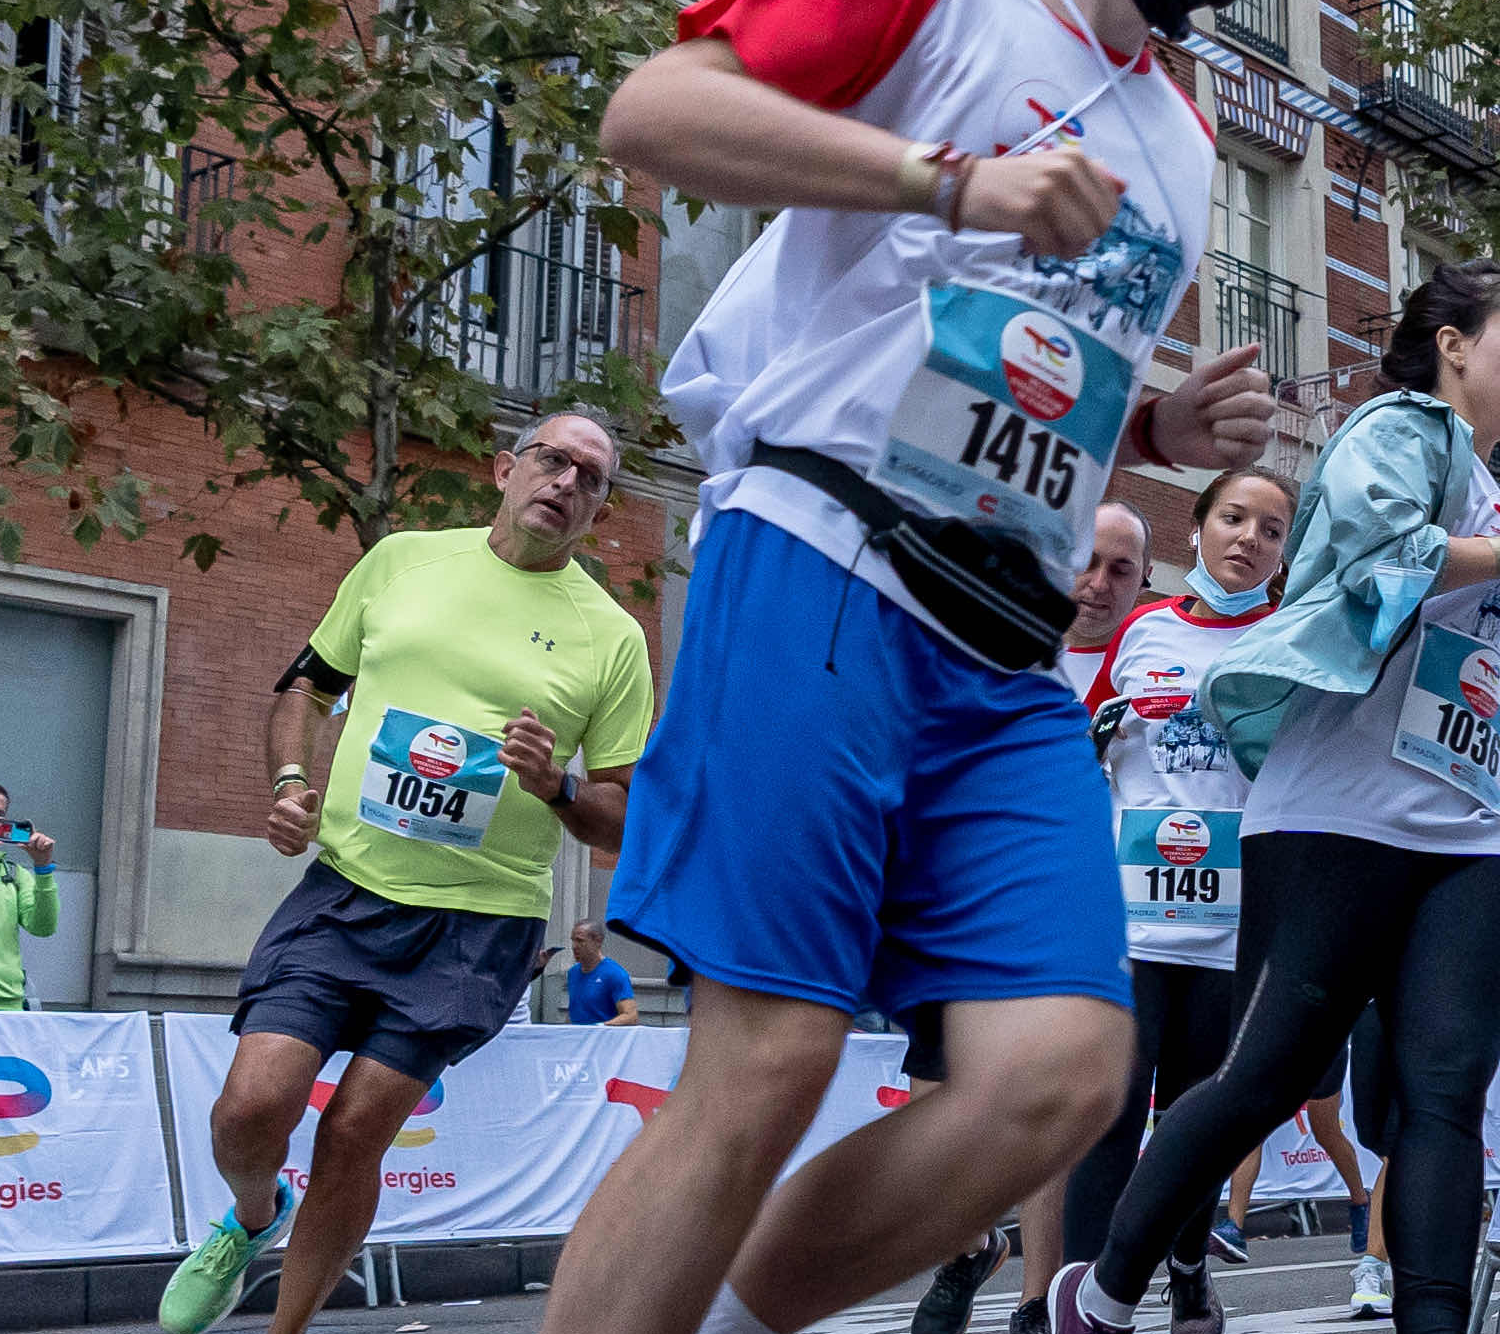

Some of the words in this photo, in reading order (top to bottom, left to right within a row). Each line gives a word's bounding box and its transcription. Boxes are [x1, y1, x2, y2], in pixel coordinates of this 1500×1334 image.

[960, 400, 1080, 510] 1415
[1437, 703, 1500, 777] 1036
[386, 771, 469, 823] 1054
[1145, 867, 1220, 903] 1149
